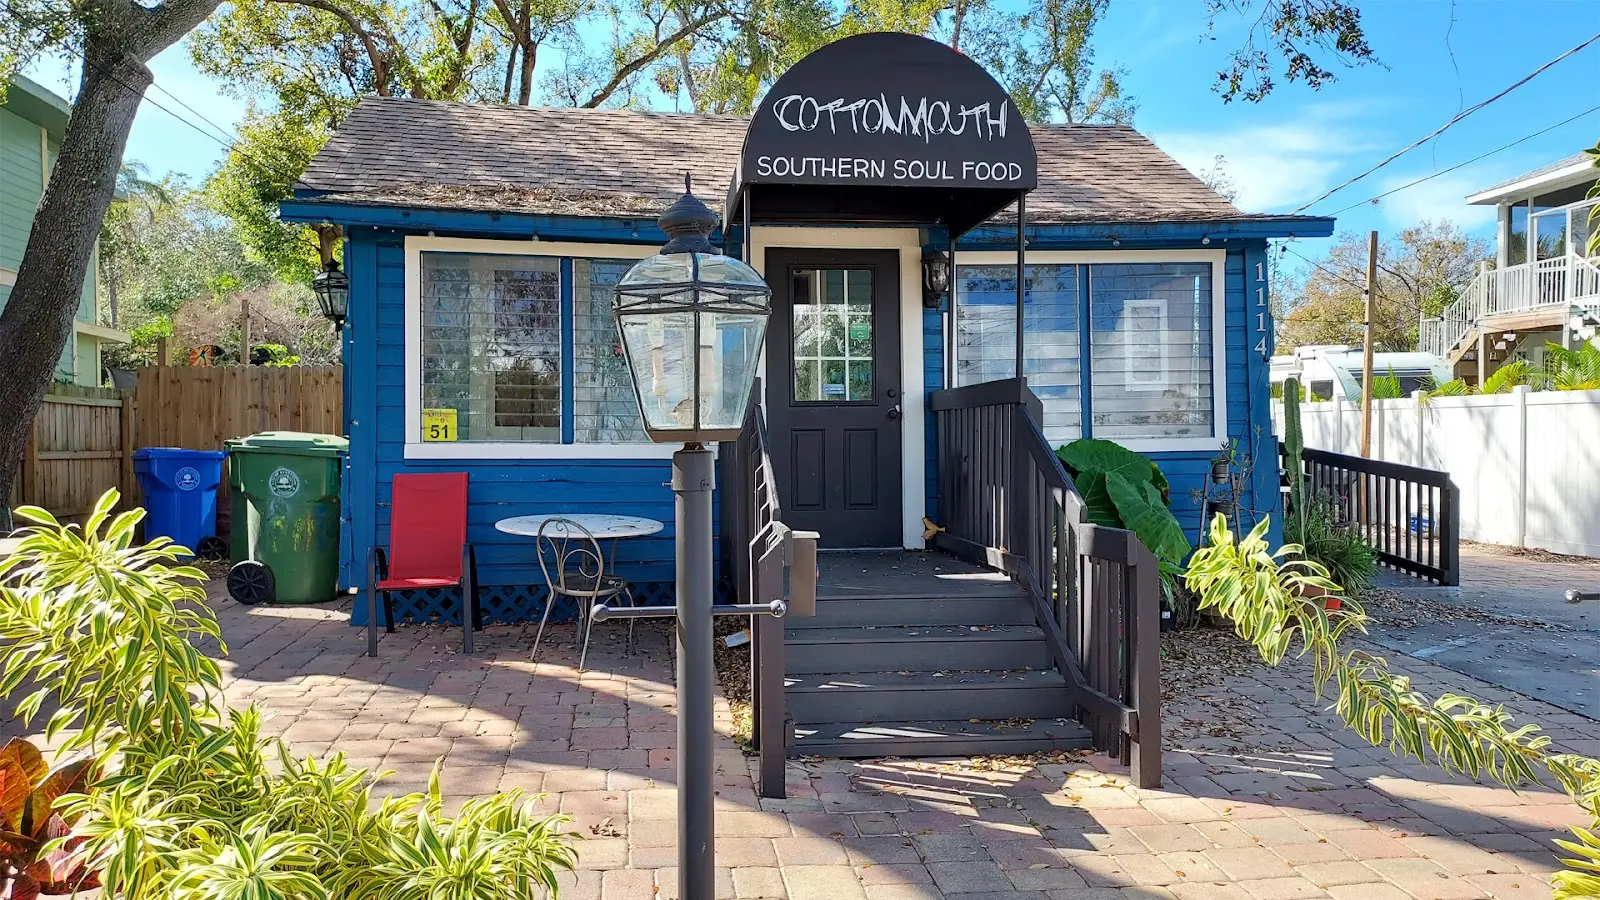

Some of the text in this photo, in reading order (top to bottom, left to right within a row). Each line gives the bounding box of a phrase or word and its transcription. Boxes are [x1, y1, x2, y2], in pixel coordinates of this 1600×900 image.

[773, 92, 1008, 144] COTTONMOUTH
[757, 156, 1022, 181] SOUTHERN SOUL FOOD
[1254, 261, 1267, 356] 1114
[430, 424, 448, 439] 51
